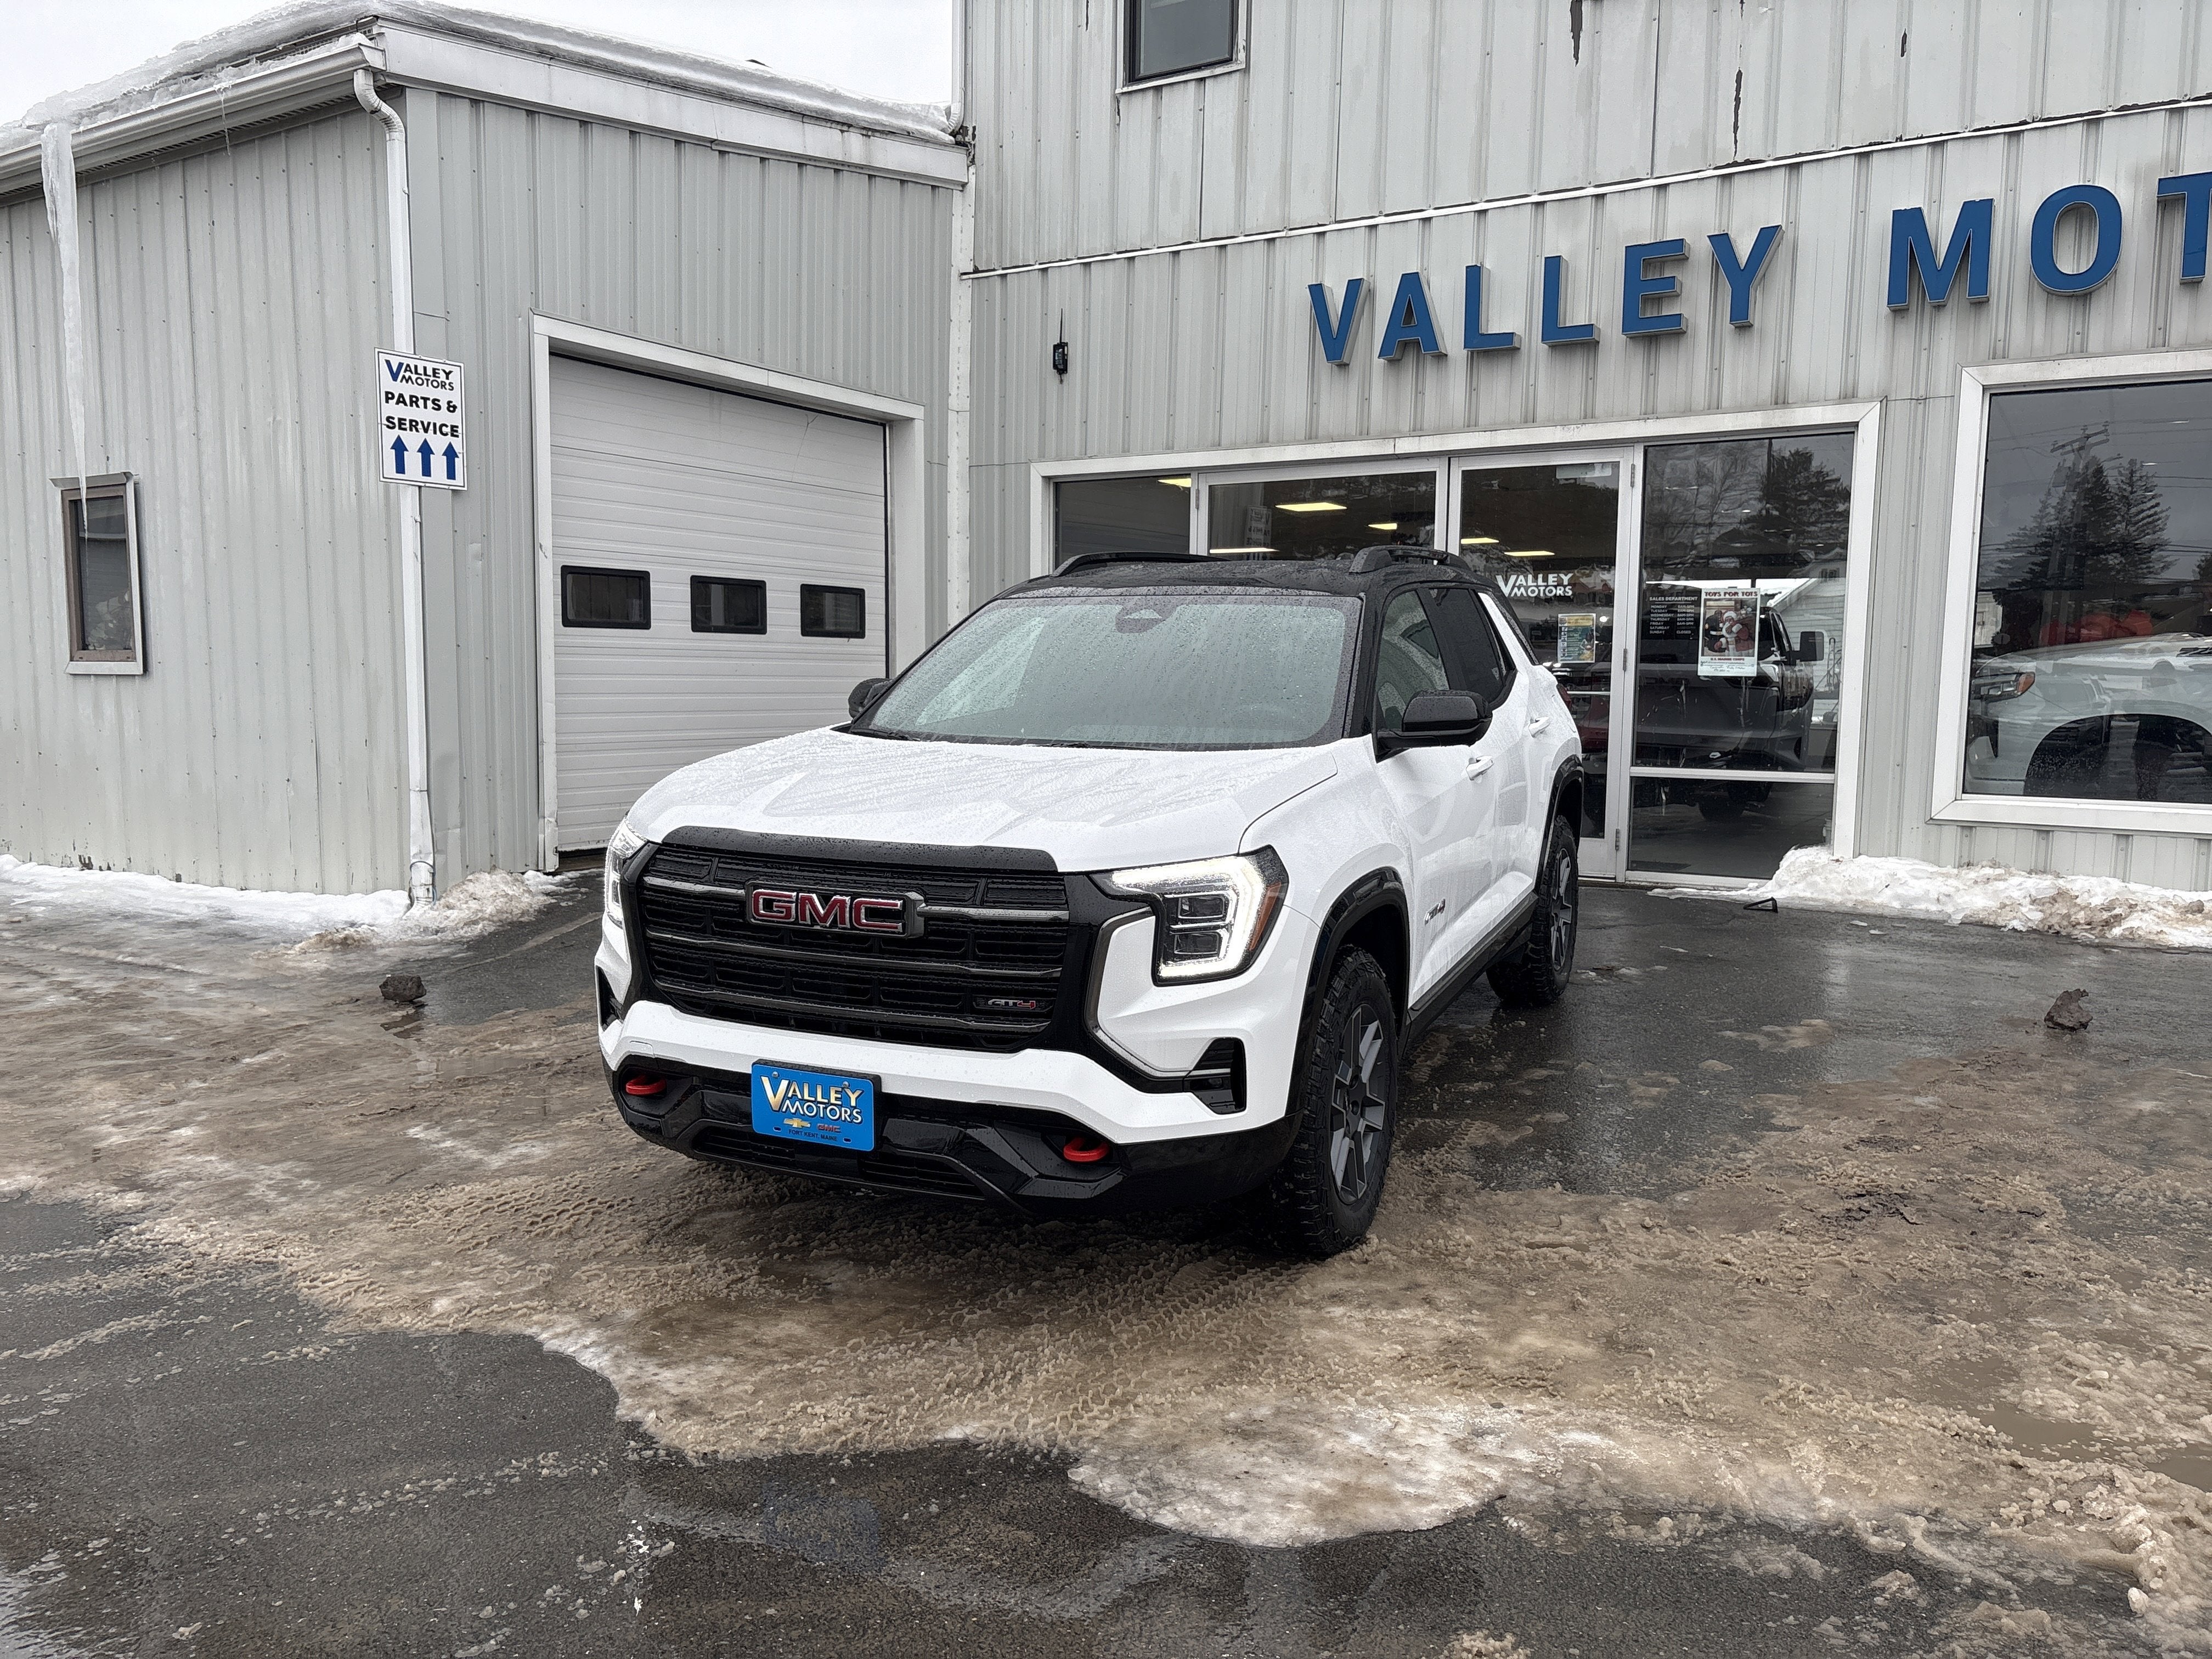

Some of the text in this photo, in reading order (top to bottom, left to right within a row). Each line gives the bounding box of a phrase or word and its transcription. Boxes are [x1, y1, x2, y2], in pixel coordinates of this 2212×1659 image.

[1307, 225, 1784, 365] VALLEY
[385, 359, 454, 382] VALLEY
[399, 375, 454, 391] MOTORS
[385, 391, 458, 413] PARTS &
[385, 415, 460, 438] SERVICE
[1496, 573, 1574, 597] VALLEY
[1510, 585, 1573, 597] MOTORS
[752, 889, 903, 934] GMC
[760, 1076, 864, 1111] VALLEY
[782, 1099, 863, 1124] MOTORS
[817, 1123, 841, 1133] GMC
